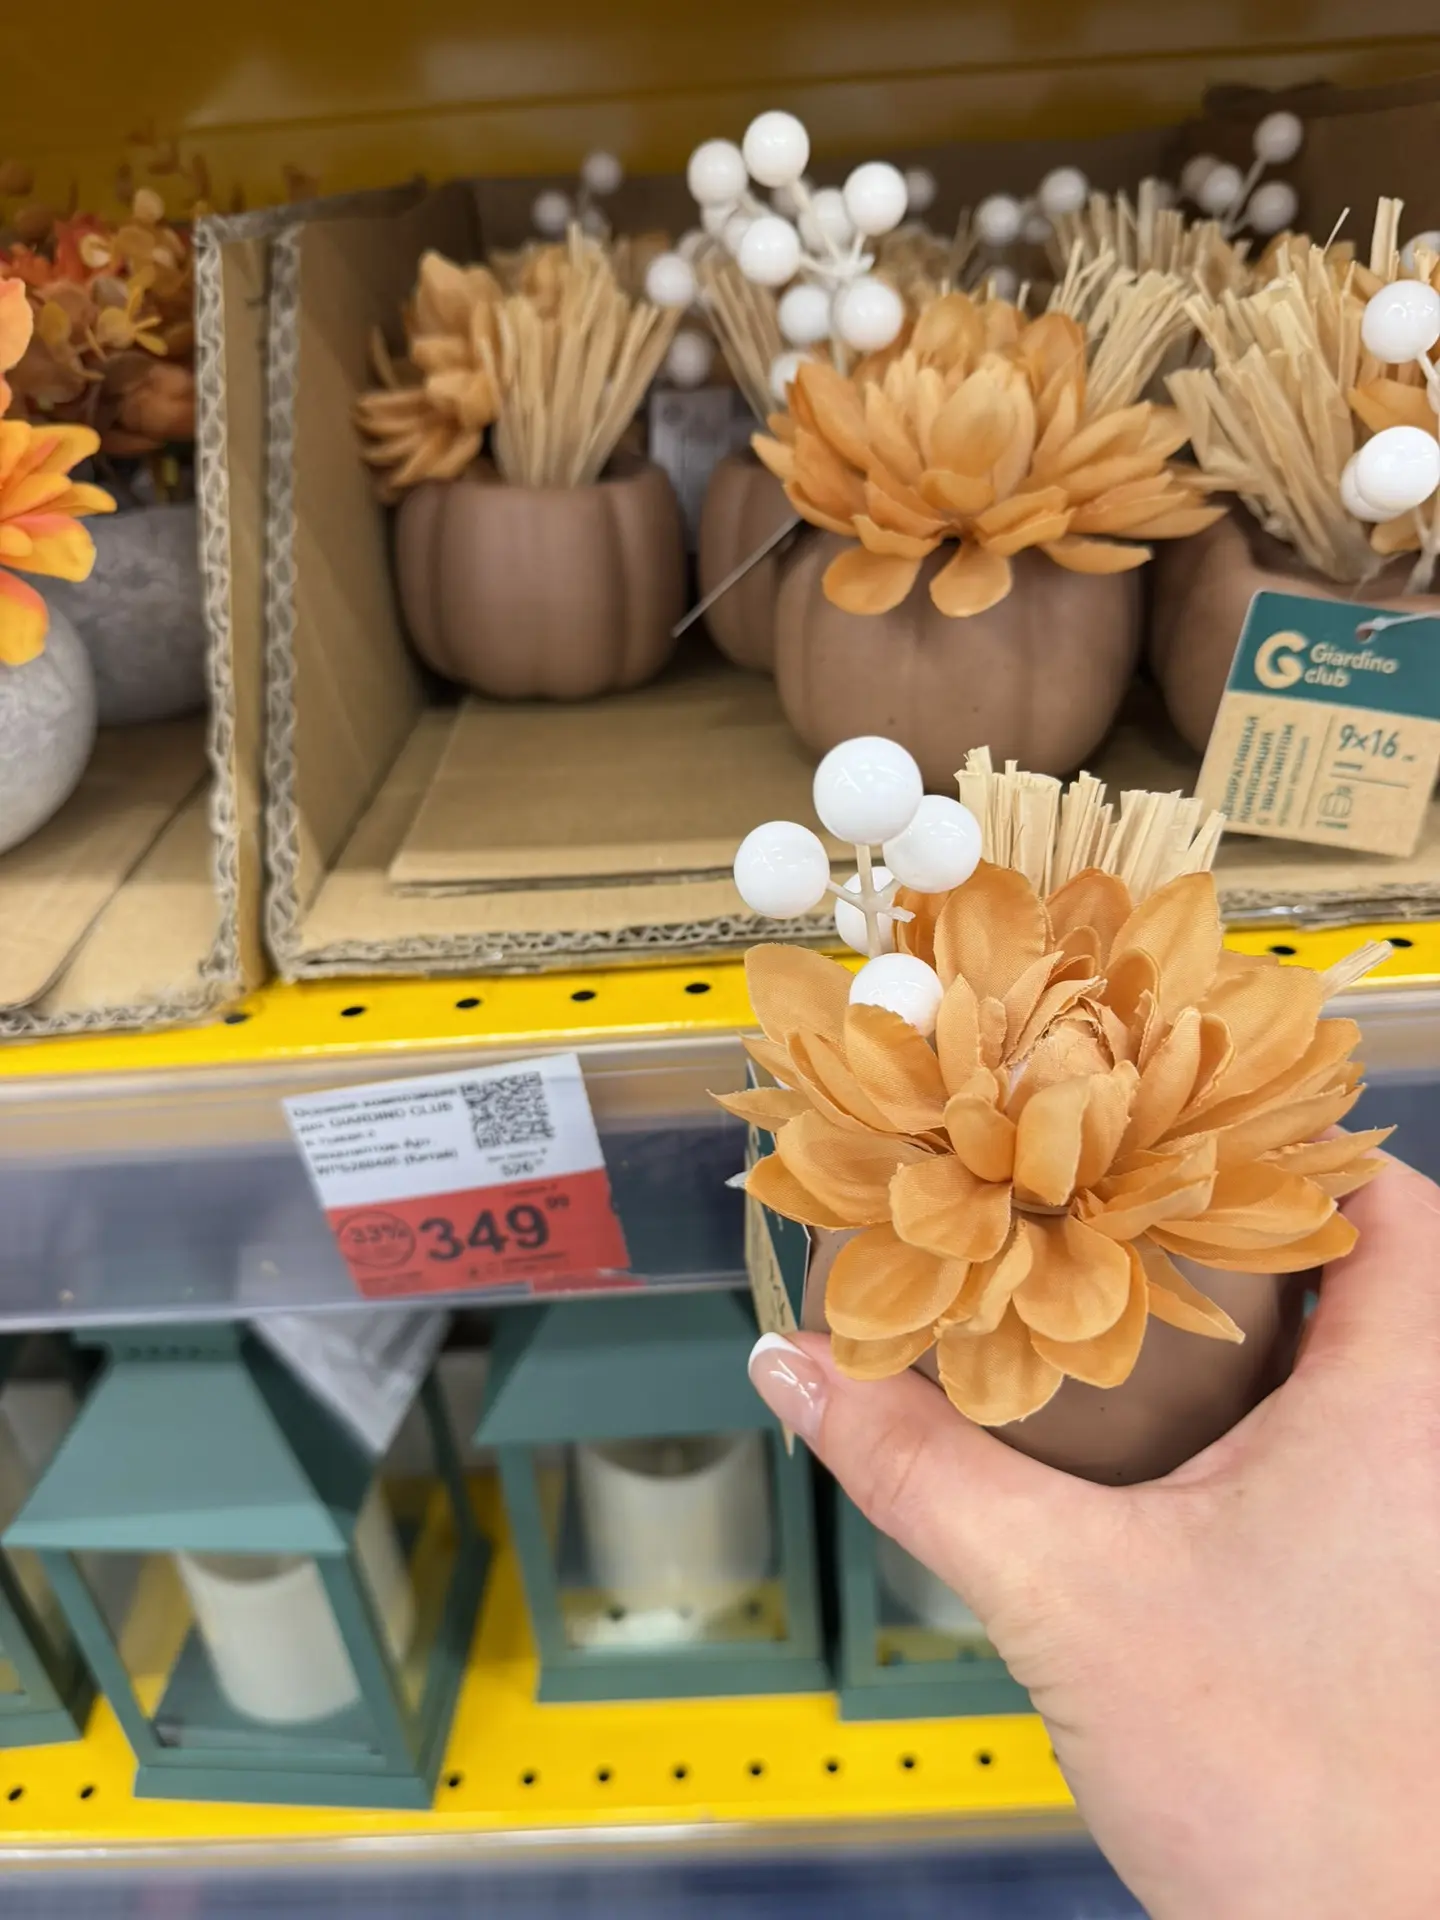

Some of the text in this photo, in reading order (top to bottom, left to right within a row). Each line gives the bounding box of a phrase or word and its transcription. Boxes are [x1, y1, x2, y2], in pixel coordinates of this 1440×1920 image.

[1310, 641, 1400, 675] Giardino
[1303, 667, 1350, 688] club
[410, 1101, 454, 1116] CLUB
[418, 1203, 551, 1263] 349
